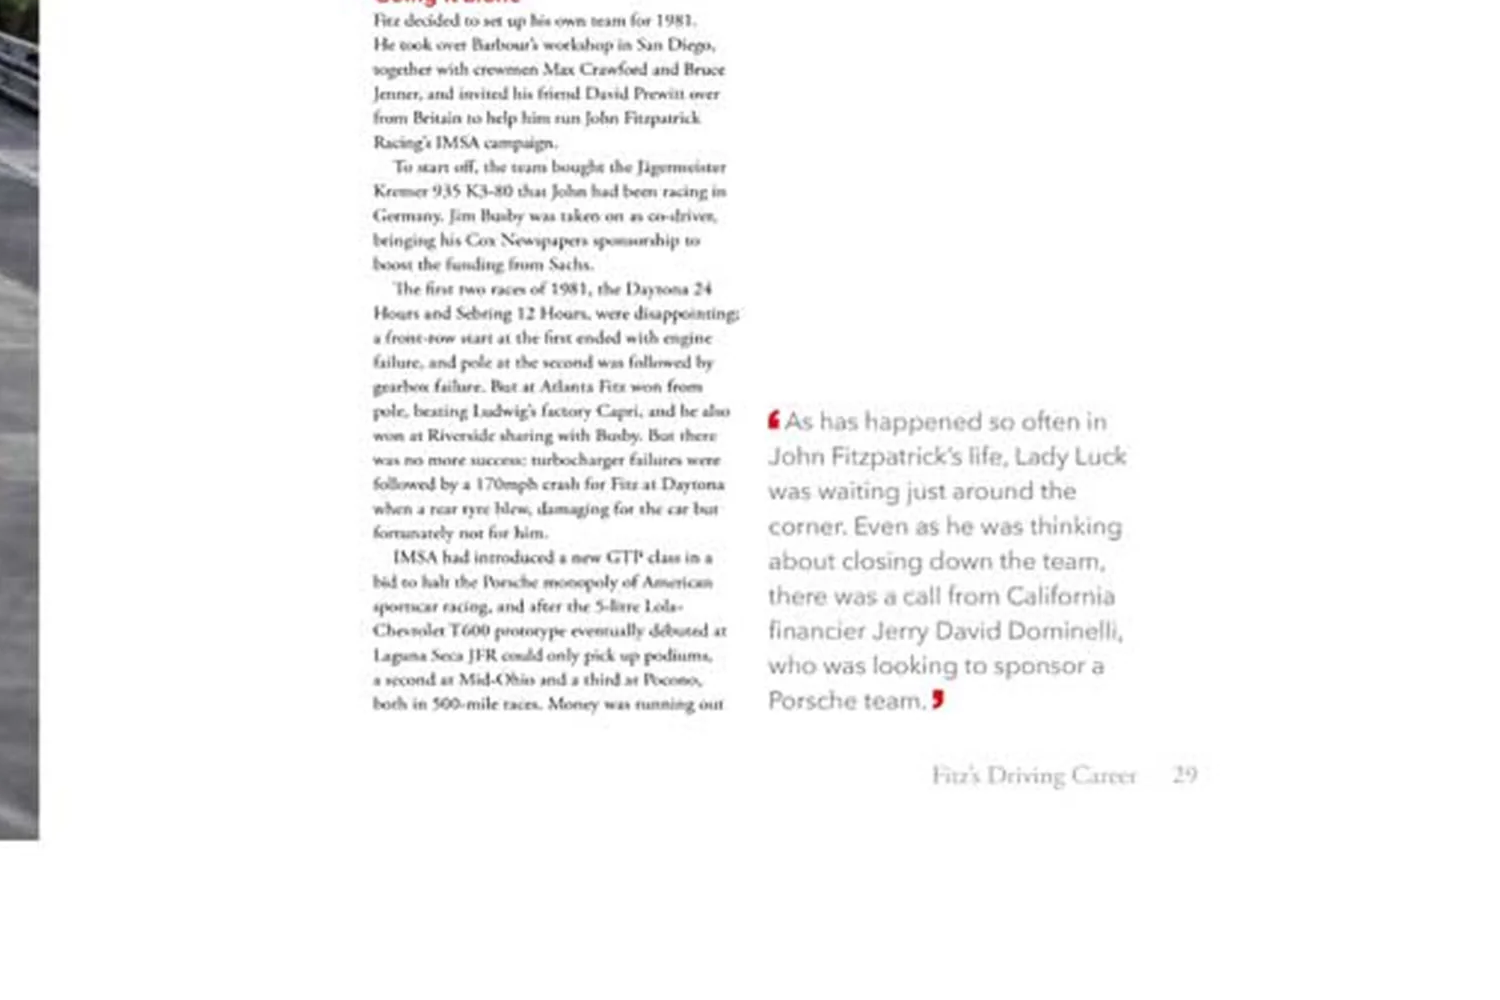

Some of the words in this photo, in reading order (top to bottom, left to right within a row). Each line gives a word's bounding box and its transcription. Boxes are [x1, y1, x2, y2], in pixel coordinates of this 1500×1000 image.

[373, 109, 408, 124] from
[413, 110, 462, 125] Britain
[467, 114, 483, 124] to
[486, 110, 518, 129] help
[522, 110, 551, 124] him
[555, 115, 581, 124] run
[586, 110, 619, 127] John
[624, 110, 700, 128] Fitzpatrick
[821, 411, 858, 431] has
[865, 410, 982, 436] happened
[990, 417, 1015, 431] so
[1022, 410, 1080, 431] often
[1087, 412, 1107, 430] in
[768, 446, 824, 466] John
[832, 446, 962, 471] Fitzpatrick's
[969, 445, 1008, 468] life,
[1015, 446, 1069, 471] Lady
[1075, 445, 1126, 466] Luck
[768, 487, 811, 500] was
[818, 481, 900, 506] waiting
[907, 482, 946, 506] just
[953, 480, 1033, 500] around
[1040, 480, 1076, 500] the
[768, 522, 847, 536] corner.
[855, 516, 908, 536] Even
[916, 521, 939, 536] as
[947, 516, 974, 536] he
[980, 521, 1024, 536] was
[1031, 515, 1122, 541] thinking
[394, 549, 437, 564] IMSA
[442, 549, 470, 564] had
[474, 549, 555, 564] introduced
[559, 554, 567, 564] a
[571, 554, 601, 564] new
[606, 549, 643, 565] GTP
[647, 549, 681, 564] class
[685, 553, 700, 564] in
[705, 555, 713, 564] a
[769, 551, 835, 570] about
[842, 550, 922, 576] closing
[929, 550, 993, 570] down
[1000, 550, 1036, 570] the
[1043, 554, 1105, 572] team,
[769, 585, 827, 606] there
[834, 592, 878, 606] was
[884, 592, 896, 606] a
[903, 586, 940, 606] call
[948, 584, 1000, 606] from
[1007, 584, 1115, 606] California
[769, 619, 865, 640] financier
[872, 621, 929, 646] Jerry
[936, 620, 1001, 640] David
[1008, 620, 1123, 643] Dominelli,
[768, 655, 817, 674] who
[823, 661, 866, 675] was
[873, 654, 958, 681] looking
[965, 660, 987, 674] to
[994, 661, 1085, 680] sponsor
[1092, 661, 1104, 674] a
[769, 690, 857, 710] Porsche
[987, 764, 1066, 790] Driving
[1071, 763, 1137, 785] Career
[1172, 764, 1199, 784] 29
